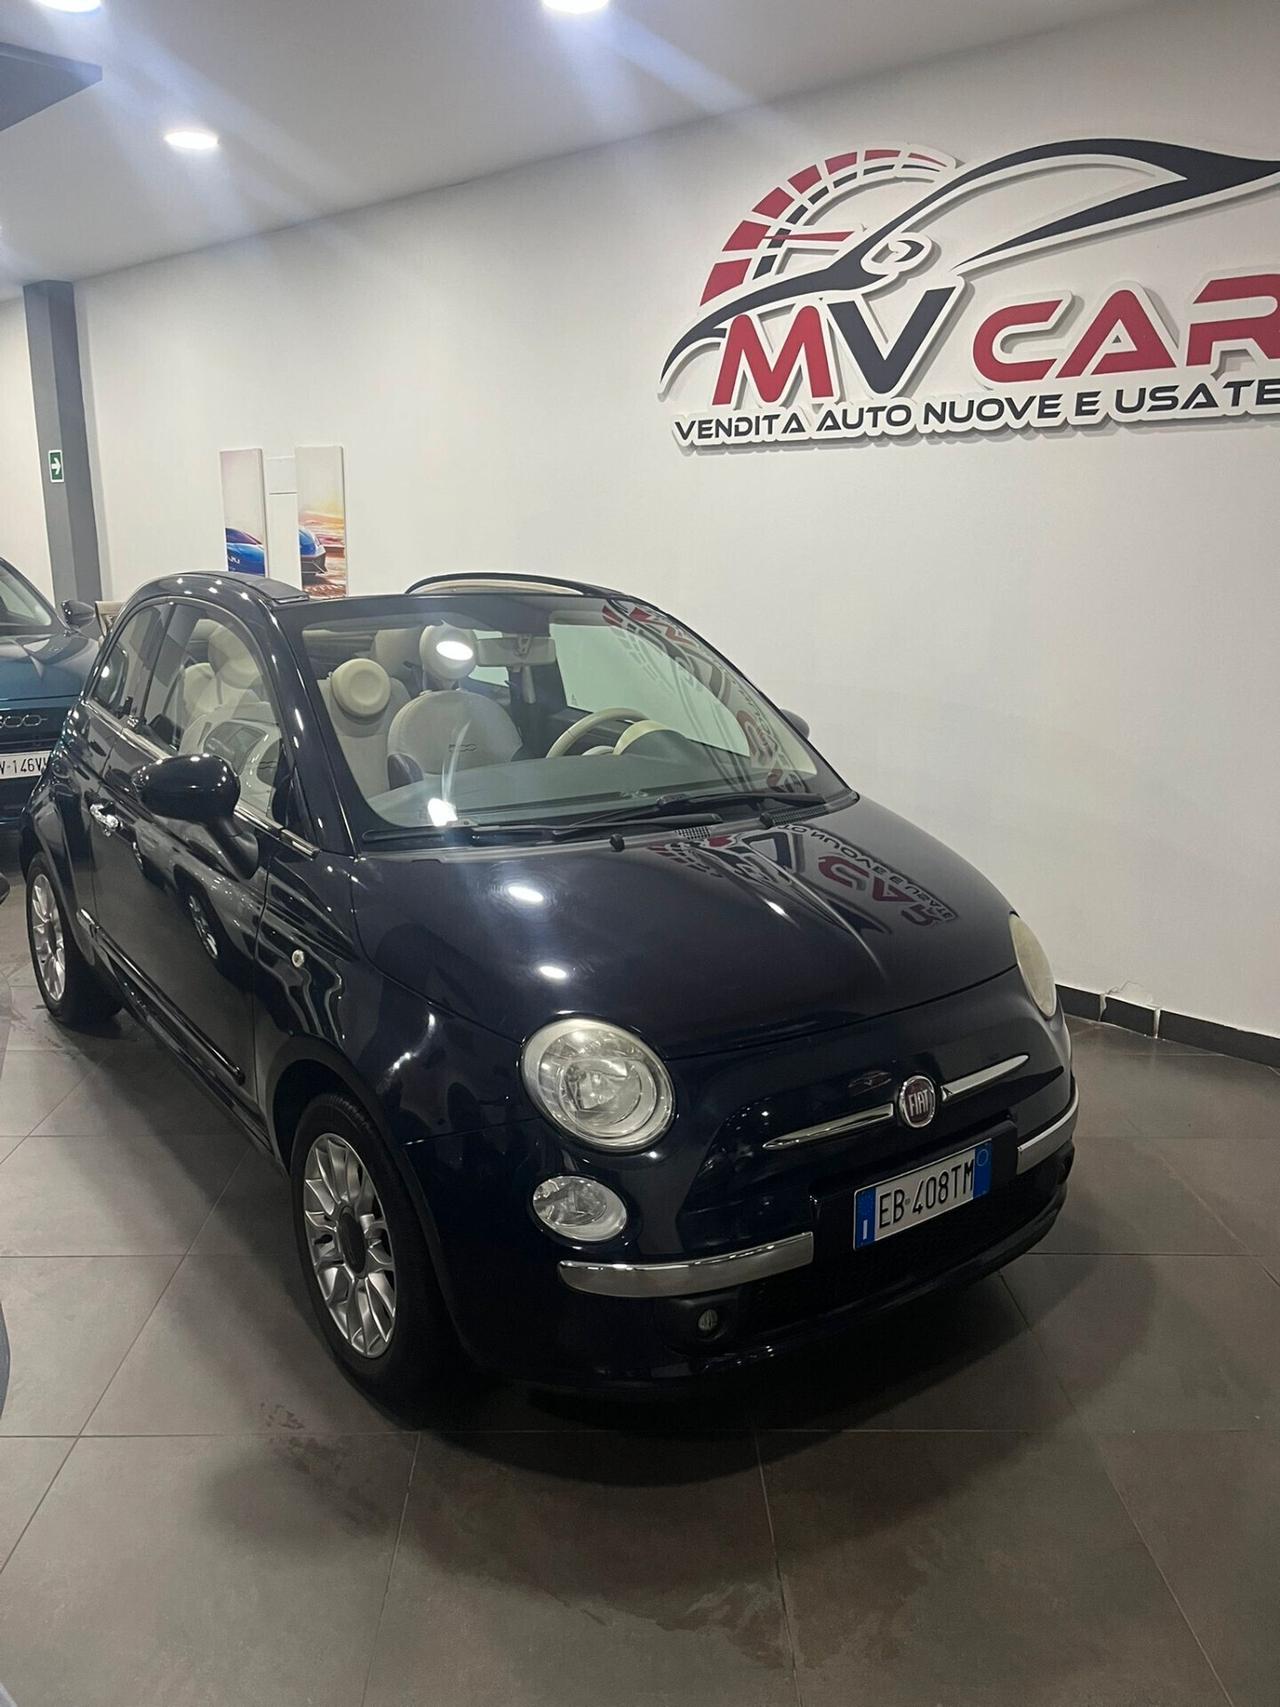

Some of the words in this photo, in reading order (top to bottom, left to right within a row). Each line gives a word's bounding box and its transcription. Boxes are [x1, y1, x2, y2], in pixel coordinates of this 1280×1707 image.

[711, 286, 955, 405] MV
[973, 273, 1280, 382] CAR
[674, 412, 806, 441] VENDITA
[816, 404, 912, 431] AUTO
[924, 394, 1063, 424] NUOVE
[1075, 391, 1102, 416] E
[1114, 378, 1280, 414] USATE
[908, 1089, 928, 1117] FIAT
